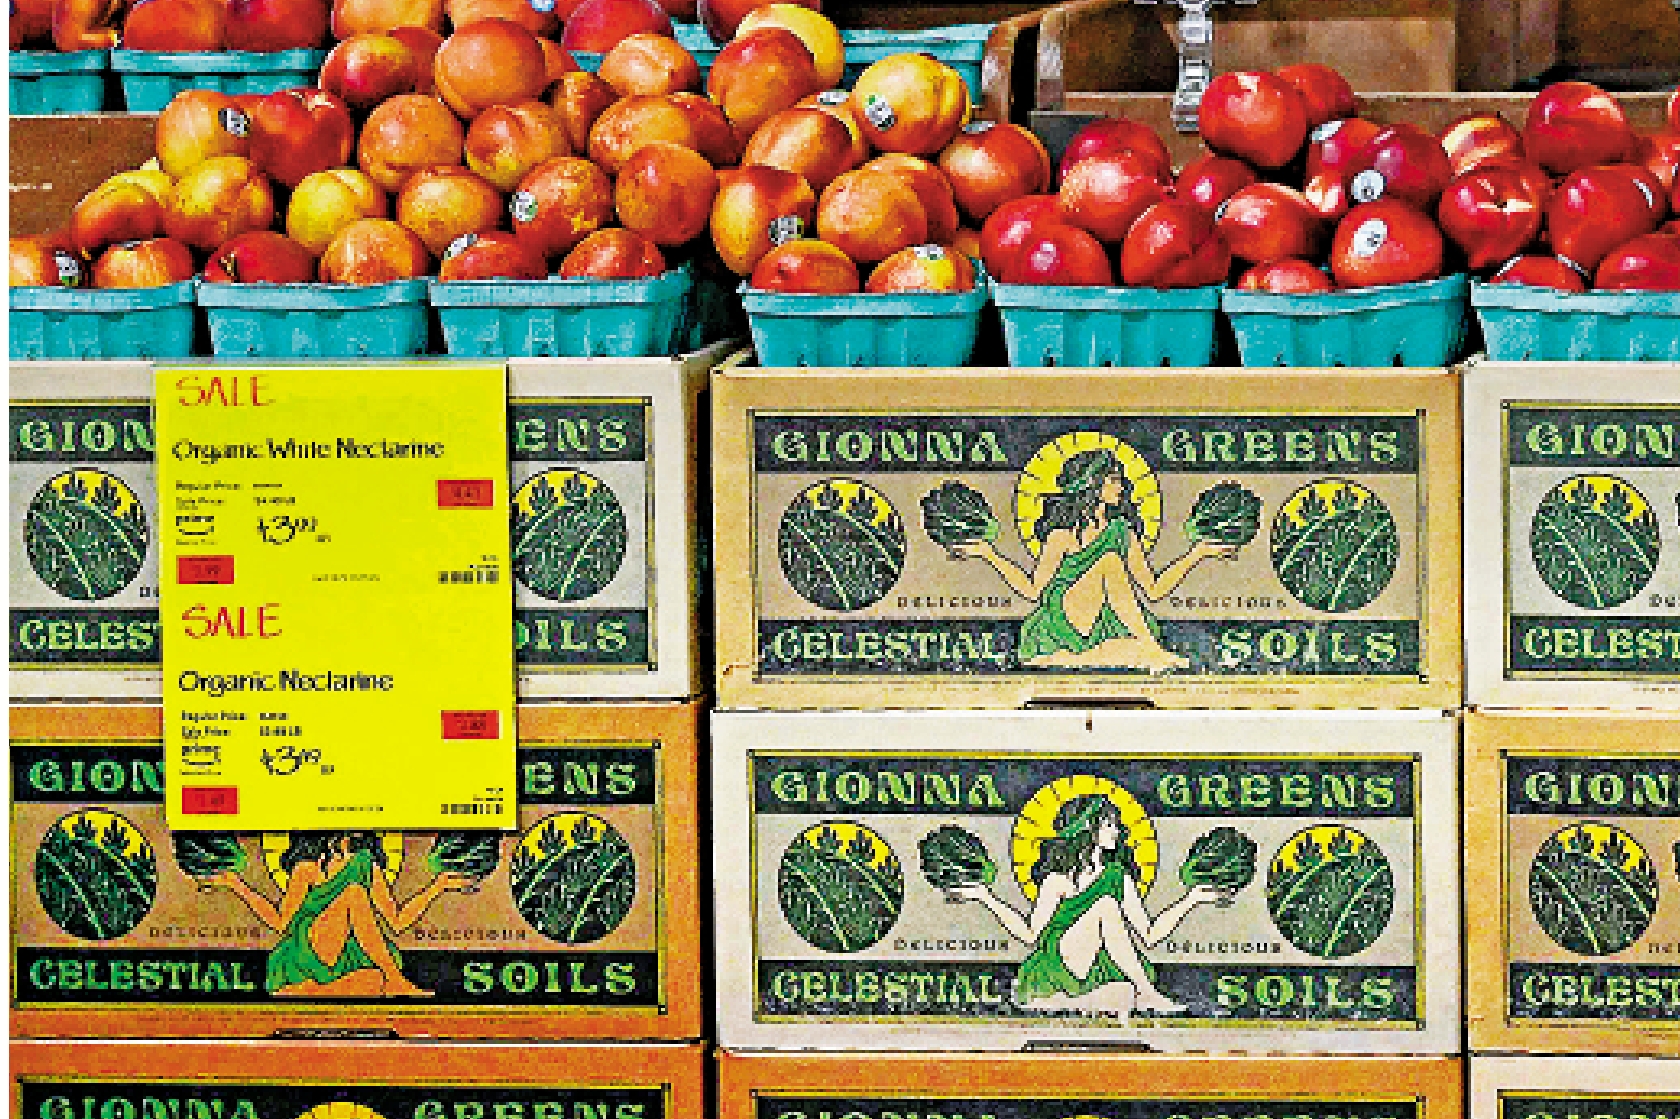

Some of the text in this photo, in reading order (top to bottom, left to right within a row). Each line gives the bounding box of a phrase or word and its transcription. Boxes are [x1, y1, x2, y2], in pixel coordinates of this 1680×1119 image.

[175, 374, 277, 408] SALE
[171, 437, 446, 465] Organic White Nectarine
[773, 429, 1401, 465] GIONNA GREENS
[896, 595, 1289, 610] DELICIOUS DELICIOUS
[181, 602, 283, 640] SALE
[772, 630, 1400, 666] CELESTIAL SOILS
[178, 668, 394, 698] Organic Nectarine
[772, 772, 1396, 810] GIONNA GREENS
[892, 937, 1283, 955] DELICIOUS DELICIOUS
[28, 959, 638, 994] CELESTIAL SOILS
[772, 970, 1395, 1011] CELESTIAL SOILS
